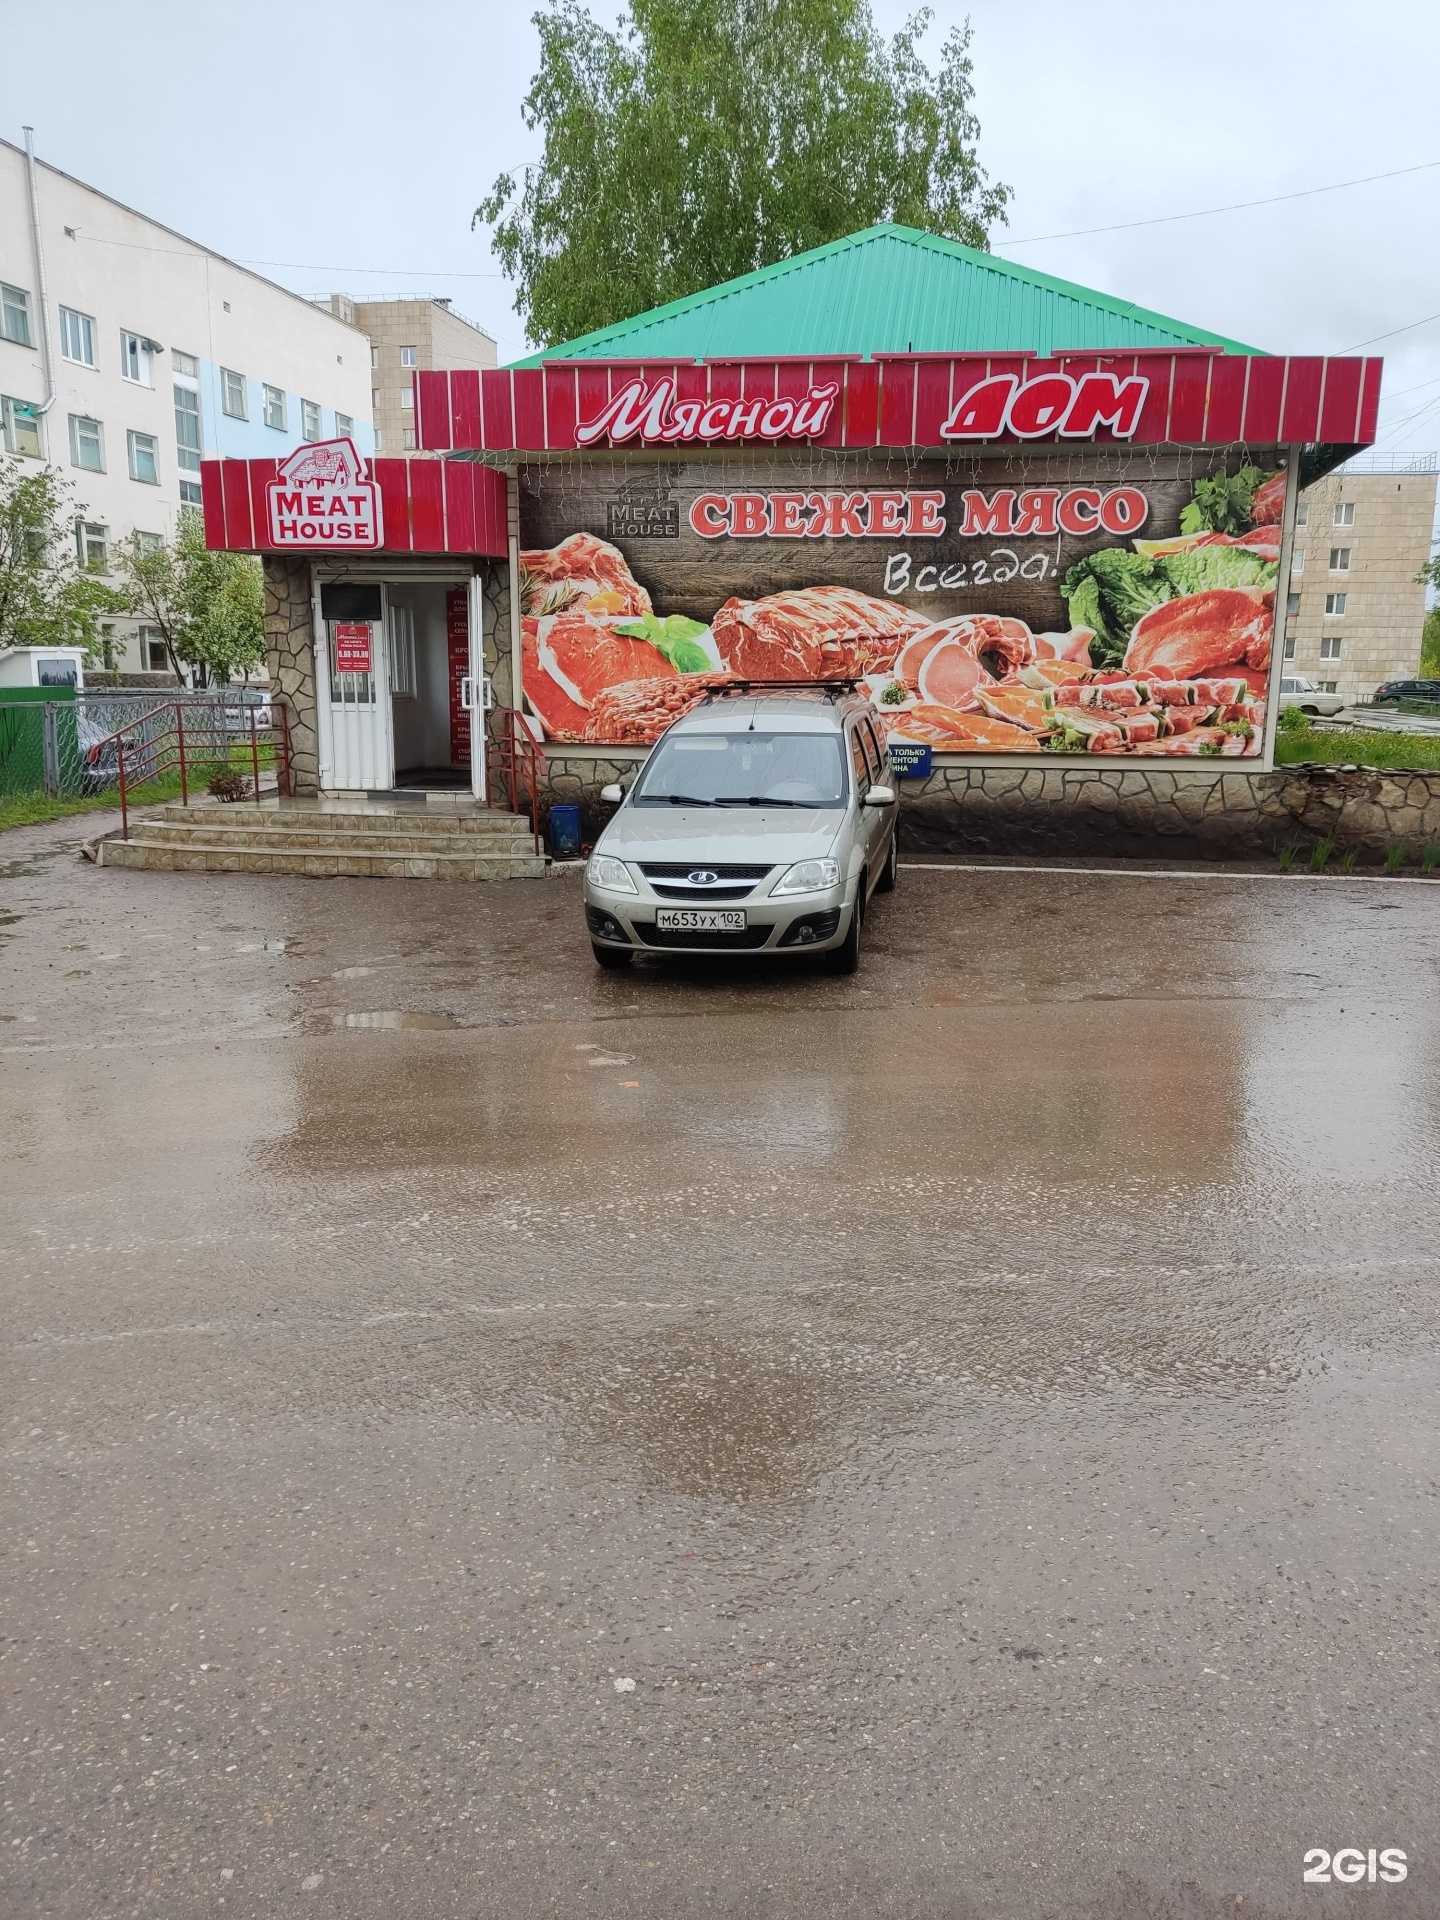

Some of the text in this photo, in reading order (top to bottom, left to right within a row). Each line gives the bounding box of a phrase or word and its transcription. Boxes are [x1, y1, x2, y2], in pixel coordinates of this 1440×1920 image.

[575, 377, 838, 443] Мясной
[689, 487, 1149, 537] СВЕЖЕЕ МЯСО
[884, 533, 1061, 595] Всегда!
[890, 756, 919, 764] ЕНТОВ
[895, 748, 926, 756] ТОЛЬКО
